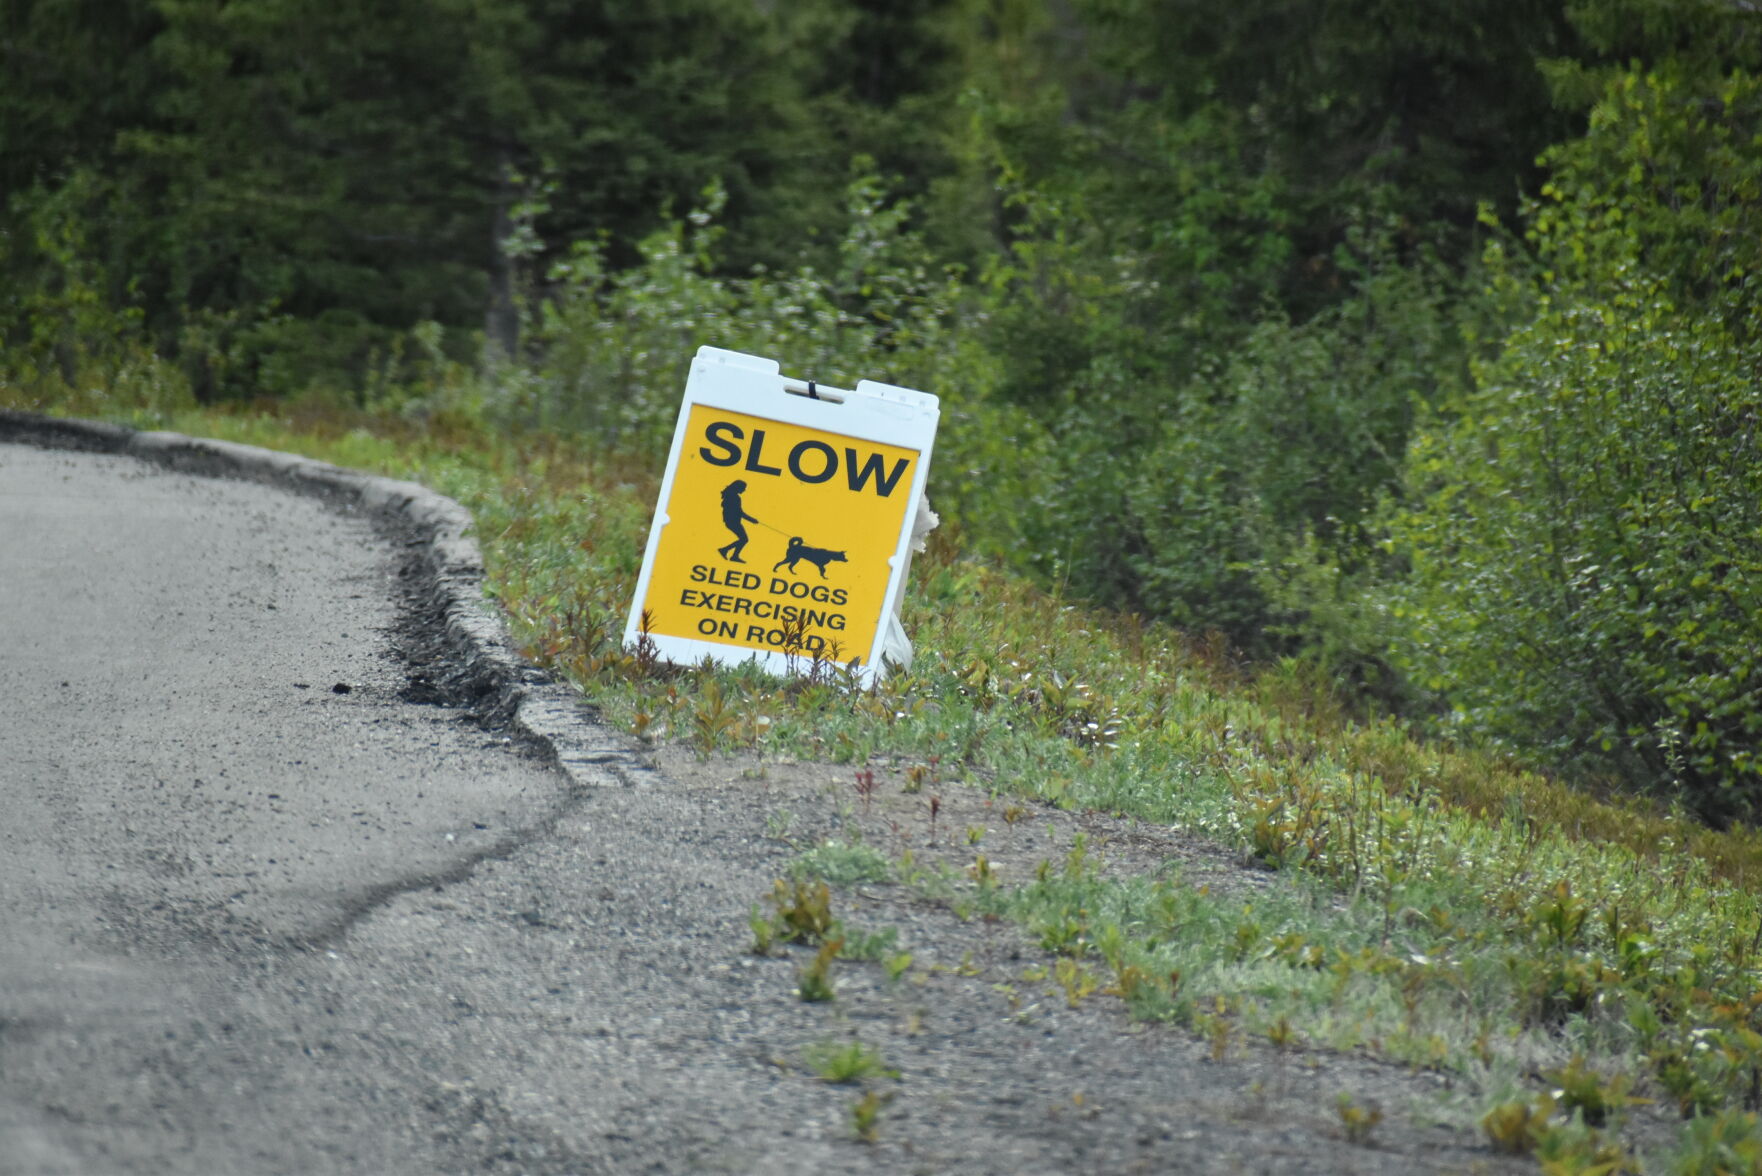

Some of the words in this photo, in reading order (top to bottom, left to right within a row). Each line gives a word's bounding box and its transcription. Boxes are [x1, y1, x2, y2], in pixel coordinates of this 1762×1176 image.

[700, 422, 910, 497] SLOW
[690, 565, 761, 590] SLED
[769, 578, 848, 605] DOGS
[680, 589, 846, 630] EXERCISING
[698, 618, 738, 638] ON
[746, 625, 825, 651] ROAD
